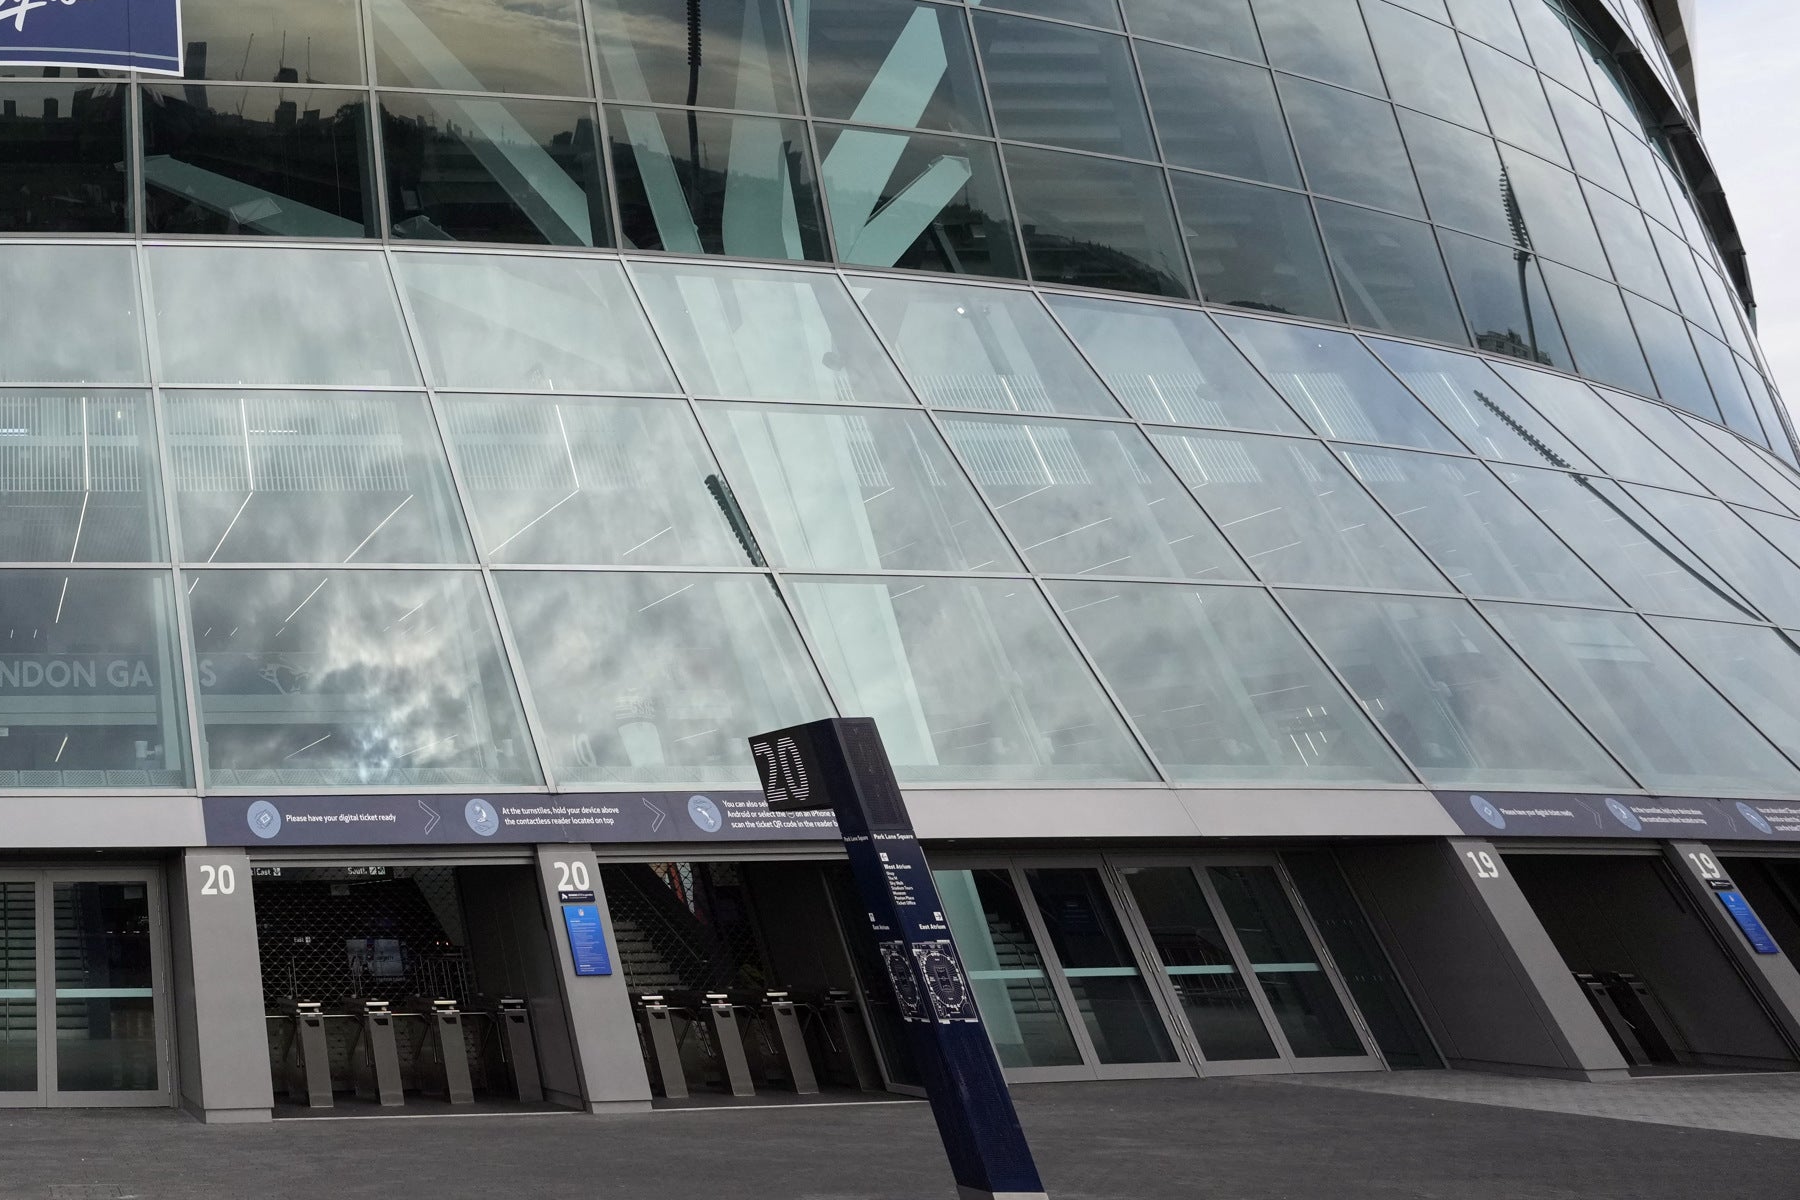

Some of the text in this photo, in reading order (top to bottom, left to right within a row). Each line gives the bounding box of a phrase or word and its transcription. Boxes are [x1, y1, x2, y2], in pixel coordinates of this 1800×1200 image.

[753, 737, 810, 802] 20
[285, 813, 396, 823] Please have your digital ticket ready
[516, 817, 550, 825] contactless
[551, 817, 571, 825] reader
[571, 817, 594, 825] located
[603, 818, 614, 826] top
[521, 806, 552, 815] turnstiles,
[552, 806, 566, 814] hold
[581, 806, 600, 814] device
[601, 806, 619, 814] above
[896, 833, 913, 841] Square
[554, 861, 590, 891] 20
[1466, 851, 1499, 879] 19
[1688, 852, 1722, 879] 19
[200, 864, 236, 895] 20
